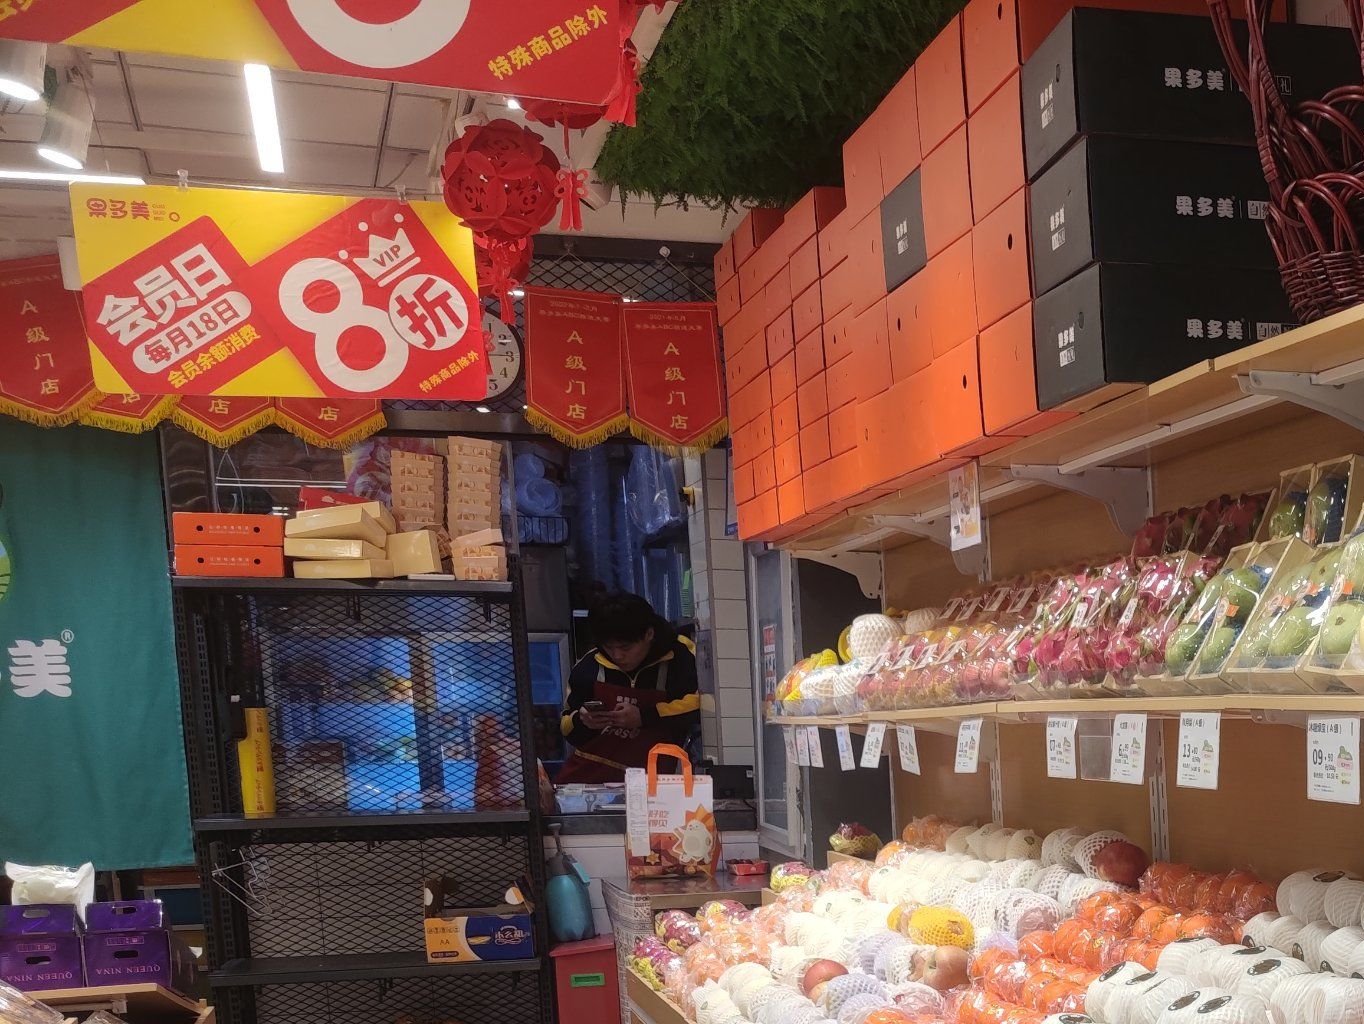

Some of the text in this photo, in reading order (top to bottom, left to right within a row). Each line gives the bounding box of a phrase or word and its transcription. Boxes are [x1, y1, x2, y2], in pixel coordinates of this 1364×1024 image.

[487, 5, 609, 81] 特殊商品除外
[1164, 67, 1224, 91] 果多美
[1176, 195, 1234, 218] 果多美
[373, 243, 402, 268] VIP
[97, 243, 232, 346] 会员日
[395, 277, 464, 348] 折
[144, 298, 241, 365] 每月18日
[279, 257, 409, 392] 8
[1187, 319, 1243, 340] 果多美
[167, 324, 261, 389] 会员余额消费
[419, 351, 479, 393] 特殊商品除外
[6, 970, 73, 982] QUEEN NINA
[95, 964, 161, 976] QUEEN NINA
